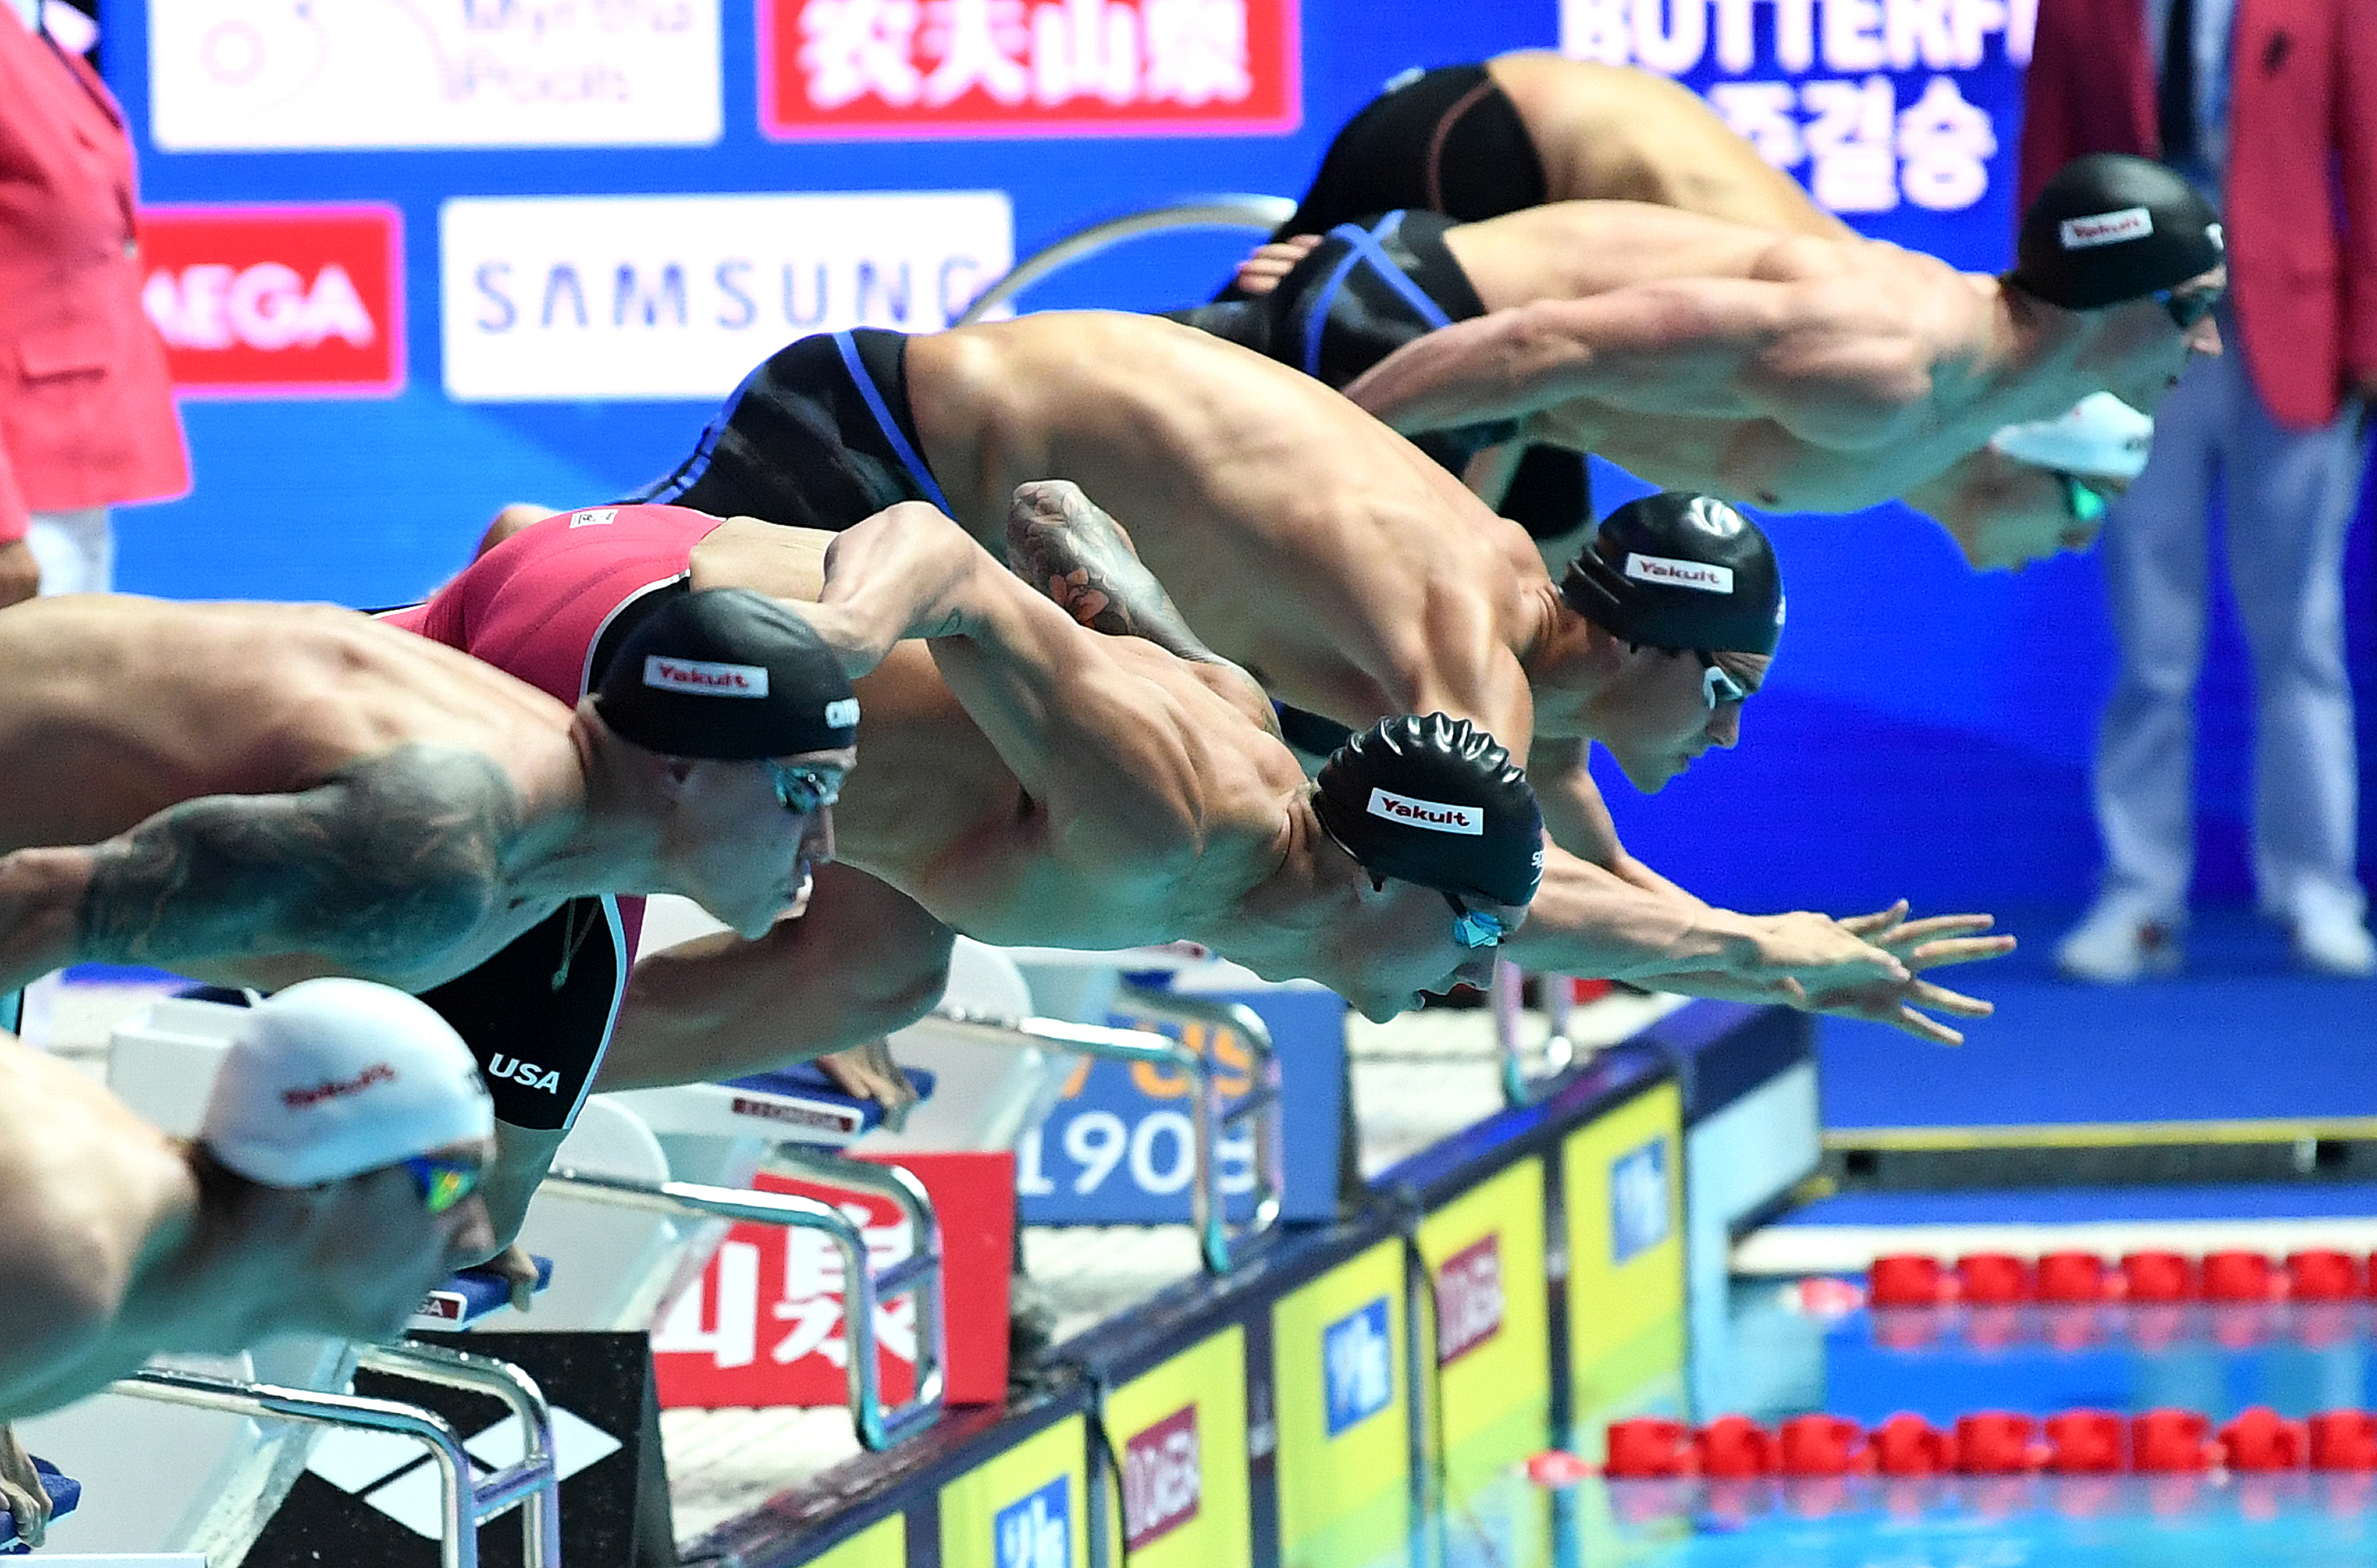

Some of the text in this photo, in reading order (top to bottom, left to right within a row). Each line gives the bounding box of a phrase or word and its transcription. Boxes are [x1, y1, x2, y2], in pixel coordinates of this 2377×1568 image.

[1641, 560, 1720, 584] Yakult
[660, 664, 750, 689] Yakult
[1382, 796, 1471, 827] Yakult
[488, 1052, 561, 1095] USA
